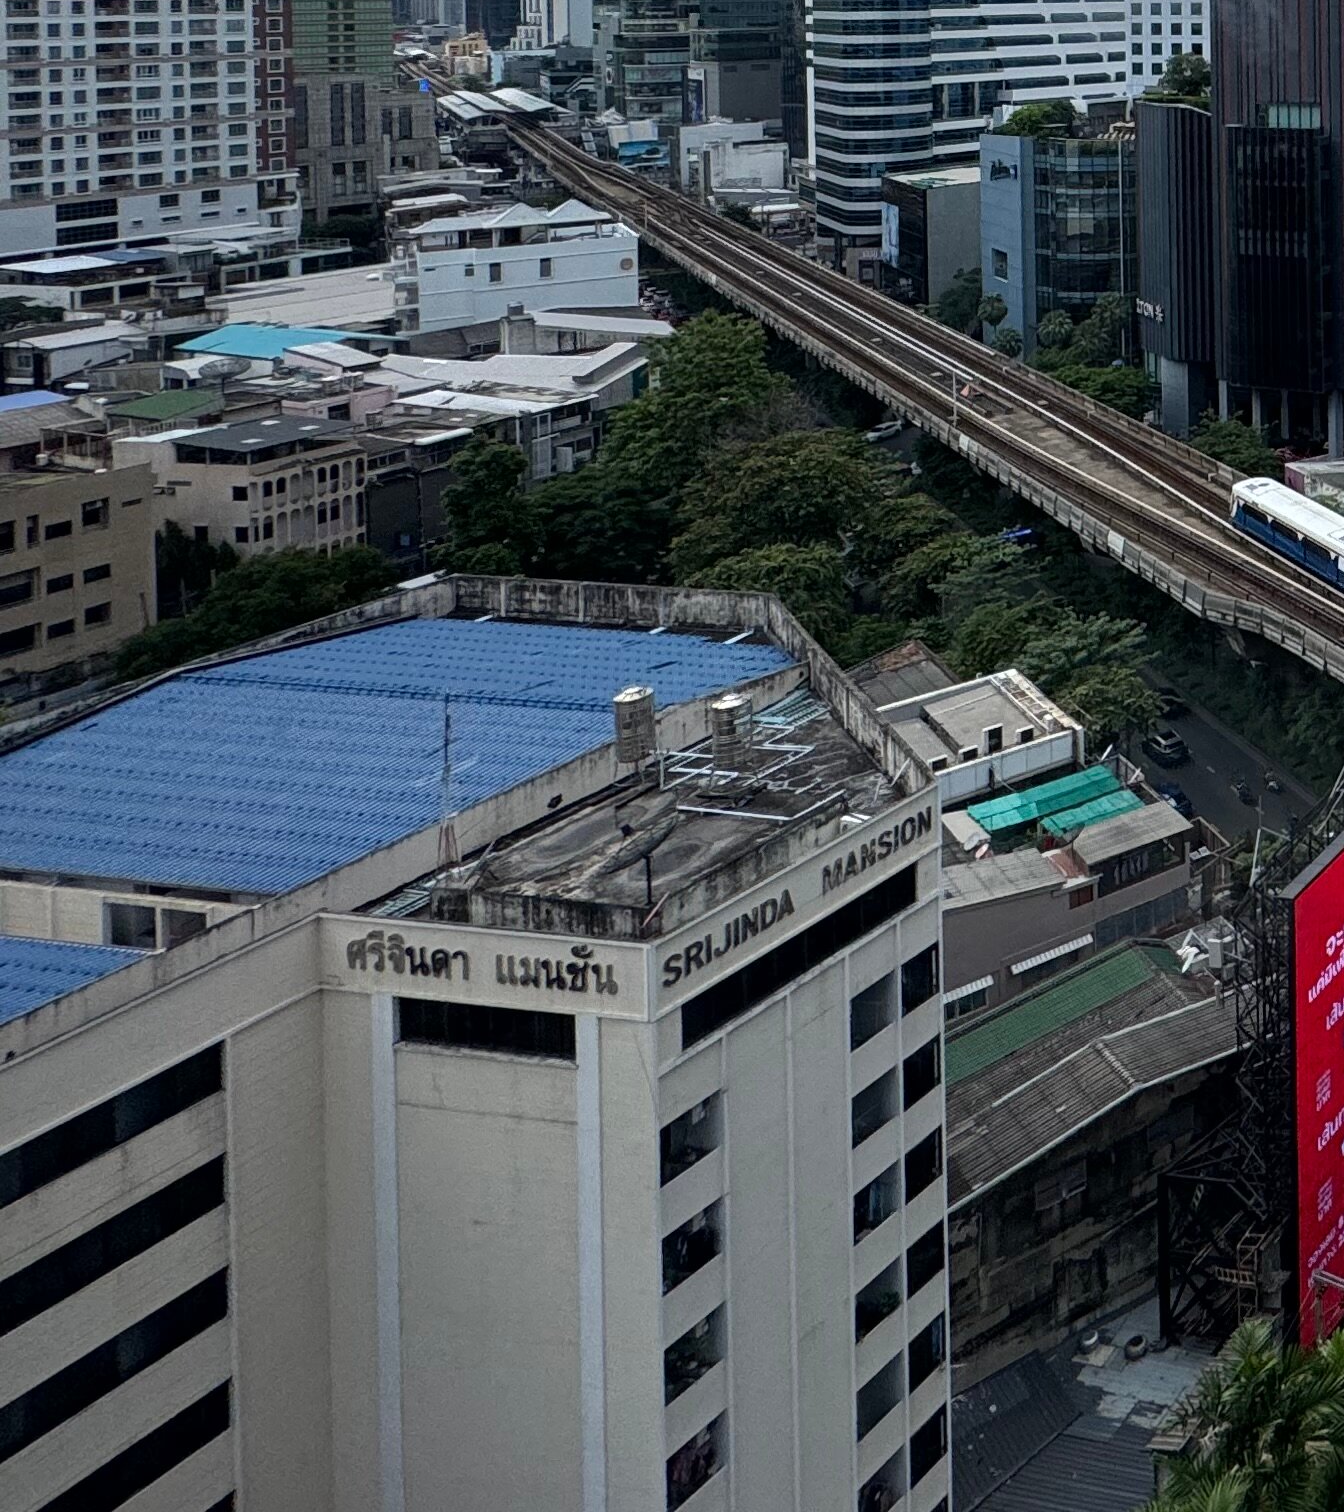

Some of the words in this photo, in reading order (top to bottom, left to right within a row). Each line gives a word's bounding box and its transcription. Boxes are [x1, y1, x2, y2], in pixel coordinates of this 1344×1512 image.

[346, 929, 471, 981] ศรีจินดา
[662, 888, 795, 988] SRIJINDA
[821, 805, 932, 897] MANSION
